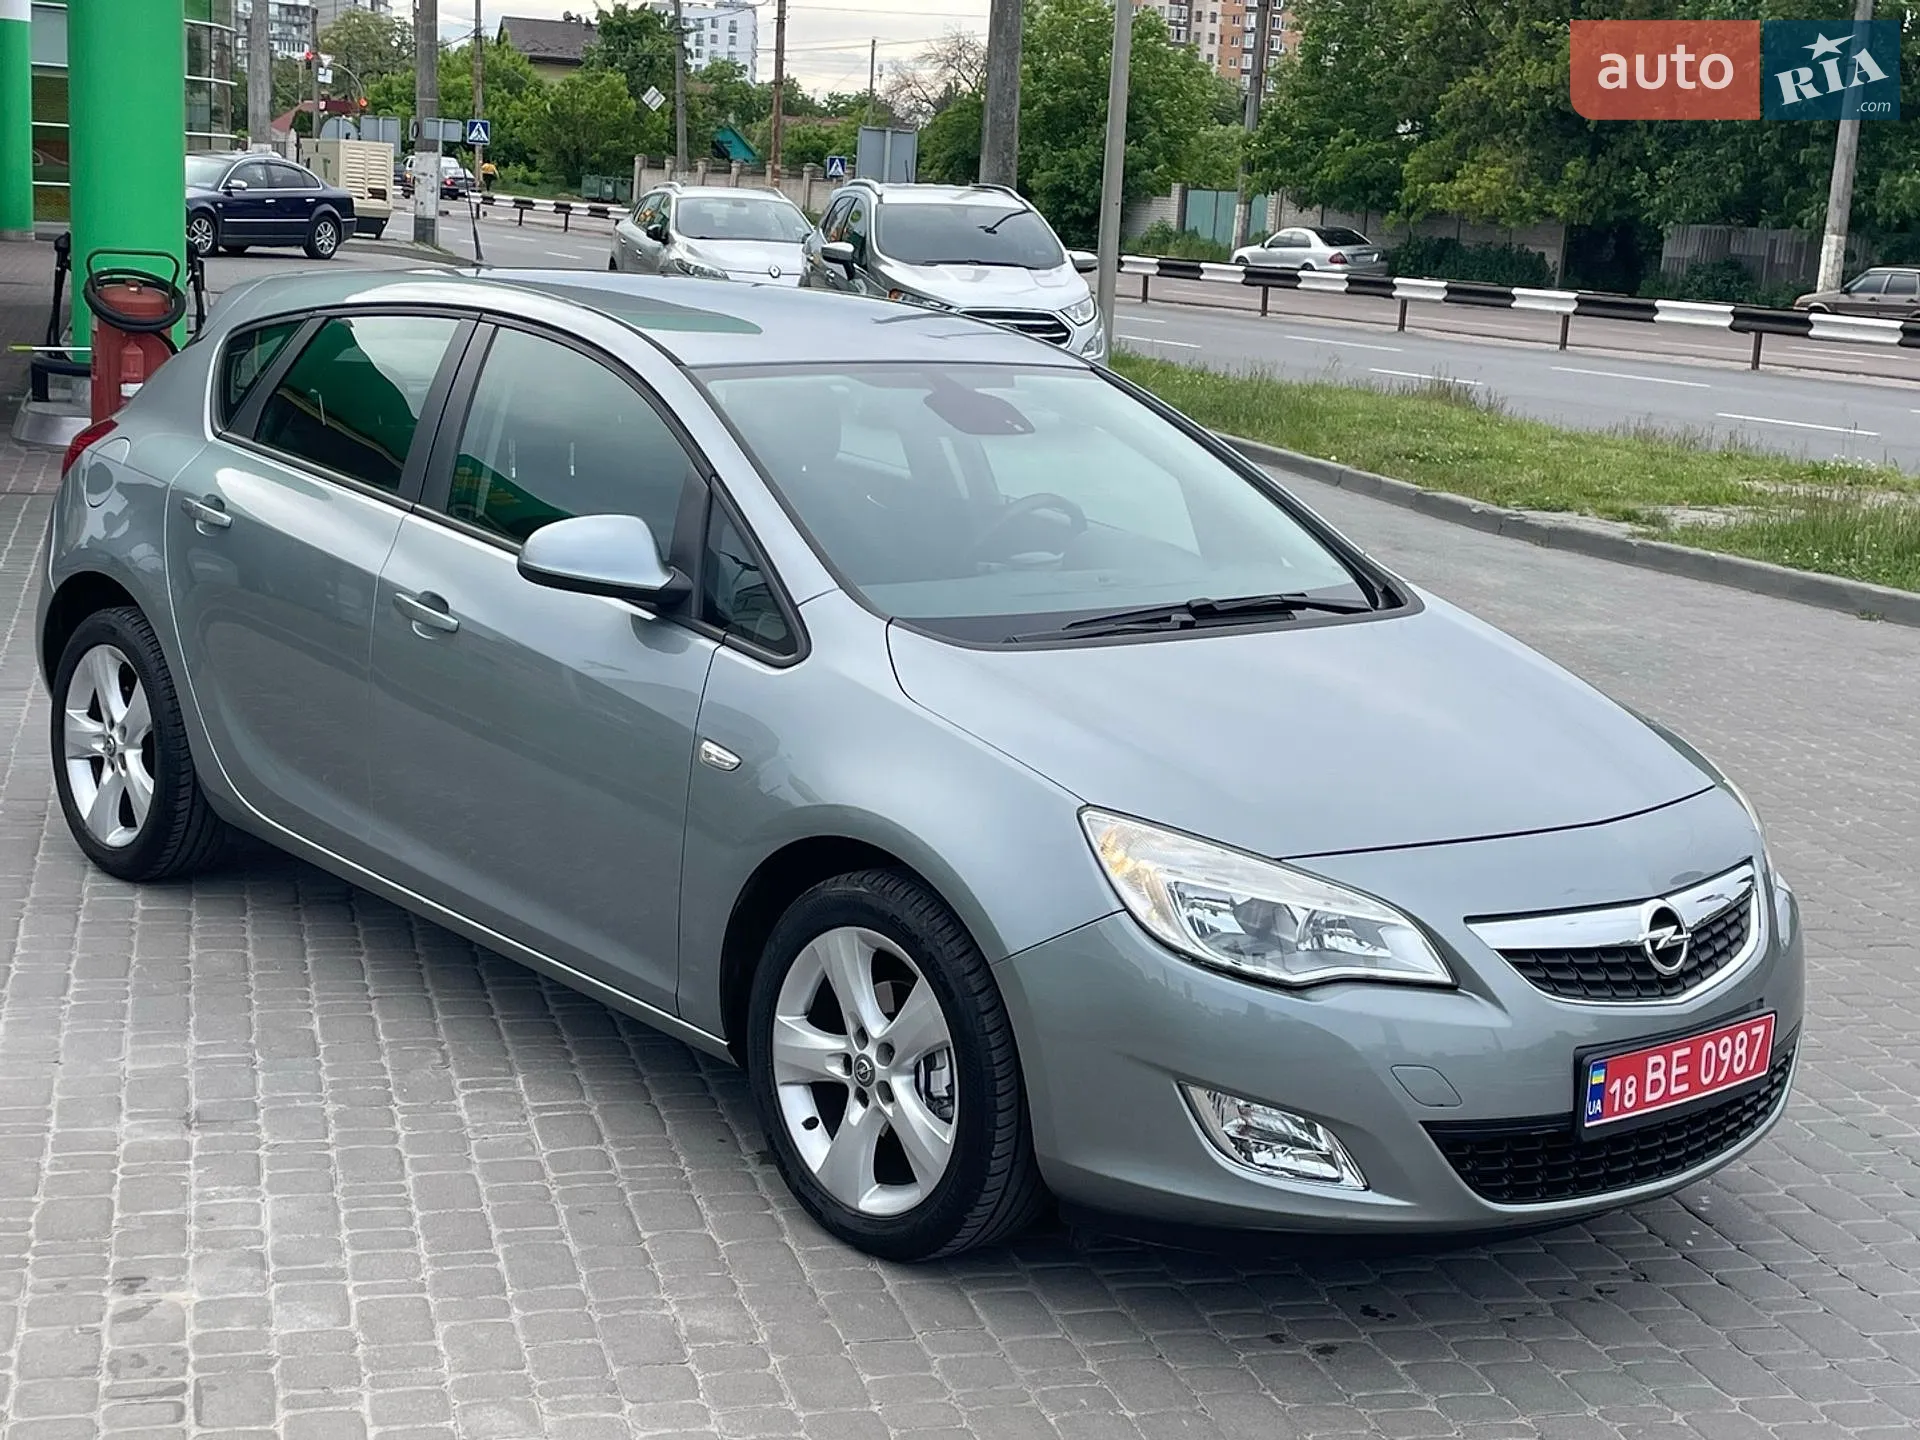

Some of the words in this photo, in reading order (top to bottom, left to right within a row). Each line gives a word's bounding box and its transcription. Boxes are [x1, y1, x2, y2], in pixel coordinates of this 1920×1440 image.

[1609, 1075, 1637, 1112] 18
[1644, 1047, 1692, 1103] BE
[1700, 1024, 1766, 1086] 0987
[1588, 1099, 1602, 1115] UA
